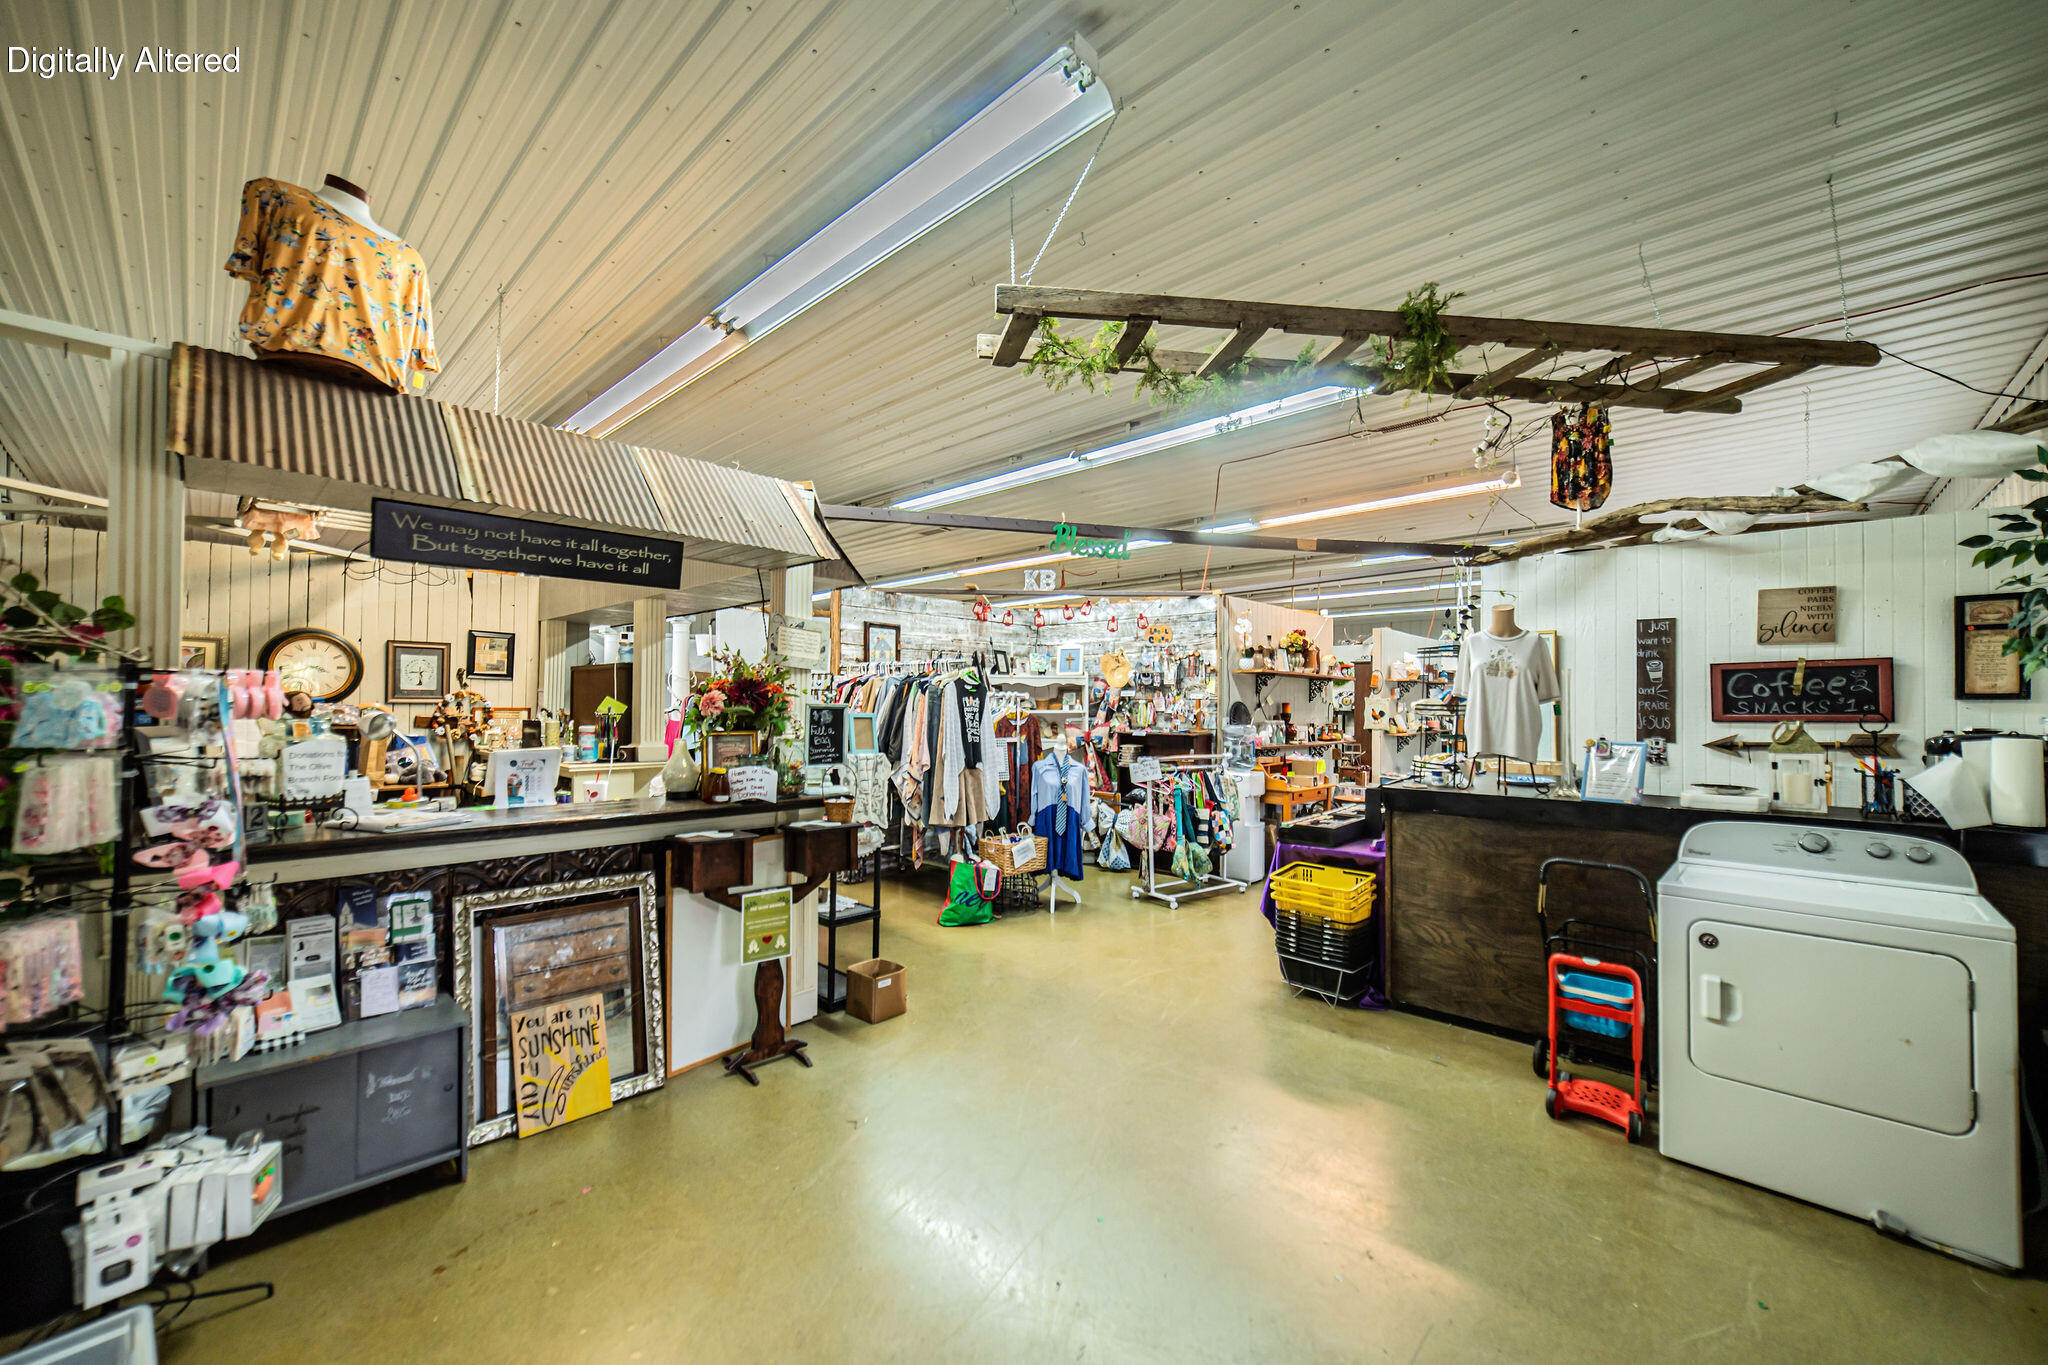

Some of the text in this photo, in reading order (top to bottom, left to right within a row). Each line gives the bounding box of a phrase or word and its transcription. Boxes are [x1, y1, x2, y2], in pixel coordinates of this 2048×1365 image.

[391, 511, 671, 563] We may not have it all together,
[1050, 523, 1132, 561] Blessed
[411, 533, 649, 575] But together we have it all
[1023, 569, 1057, 591] KB
[1798, 587, 1835, 595] COFFEE
[1639, 620, 1671, 633] I JUST
[1661, 636, 1672, 645] to
[1637, 649, 1660, 658] drink
[1638, 686, 1655, 695] and
[1726, 670, 1847, 699] Cofee
[1732, 701, 1831, 714] SNACKS
[1637, 712, 1671, 730] JESUS
[516, 1004, 600, 1033] You are my
[518, 1020, 600, 1060] SUNSHINE
